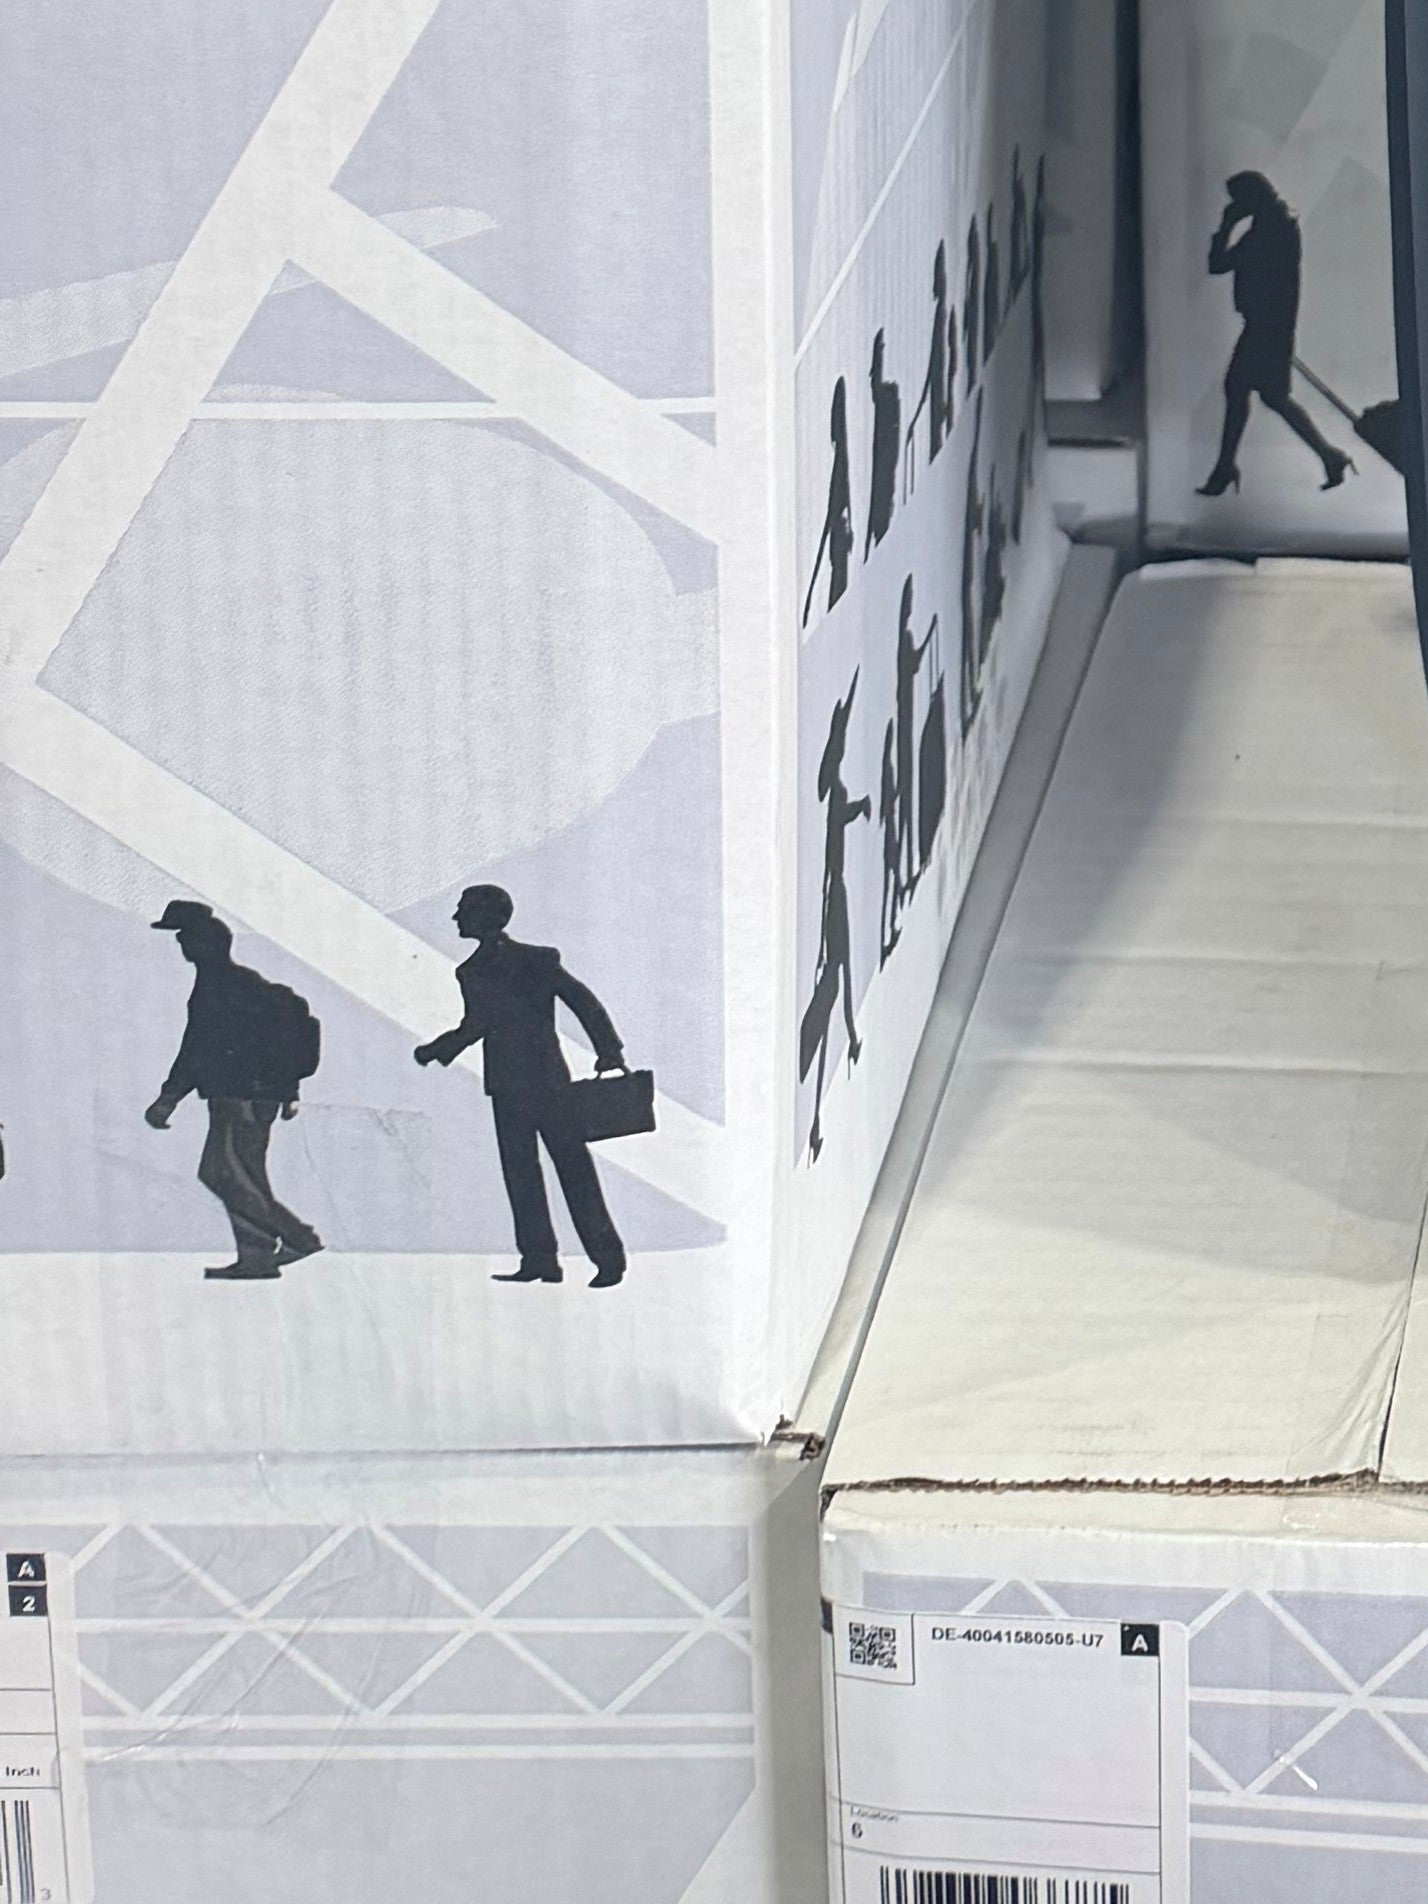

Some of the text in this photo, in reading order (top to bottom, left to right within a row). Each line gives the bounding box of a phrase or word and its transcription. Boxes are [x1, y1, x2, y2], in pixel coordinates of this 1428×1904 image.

[18, 1560, 34, 1578] A
[22, 1596, 36, 1612] 2
[931, 1626, 1104, 1648] DE-40041580505-U7
[1131, 1634, 1149, 1652] A
[5, 1766, 40, 1777] Inch
[851, 1822, 863, 1840] 6
